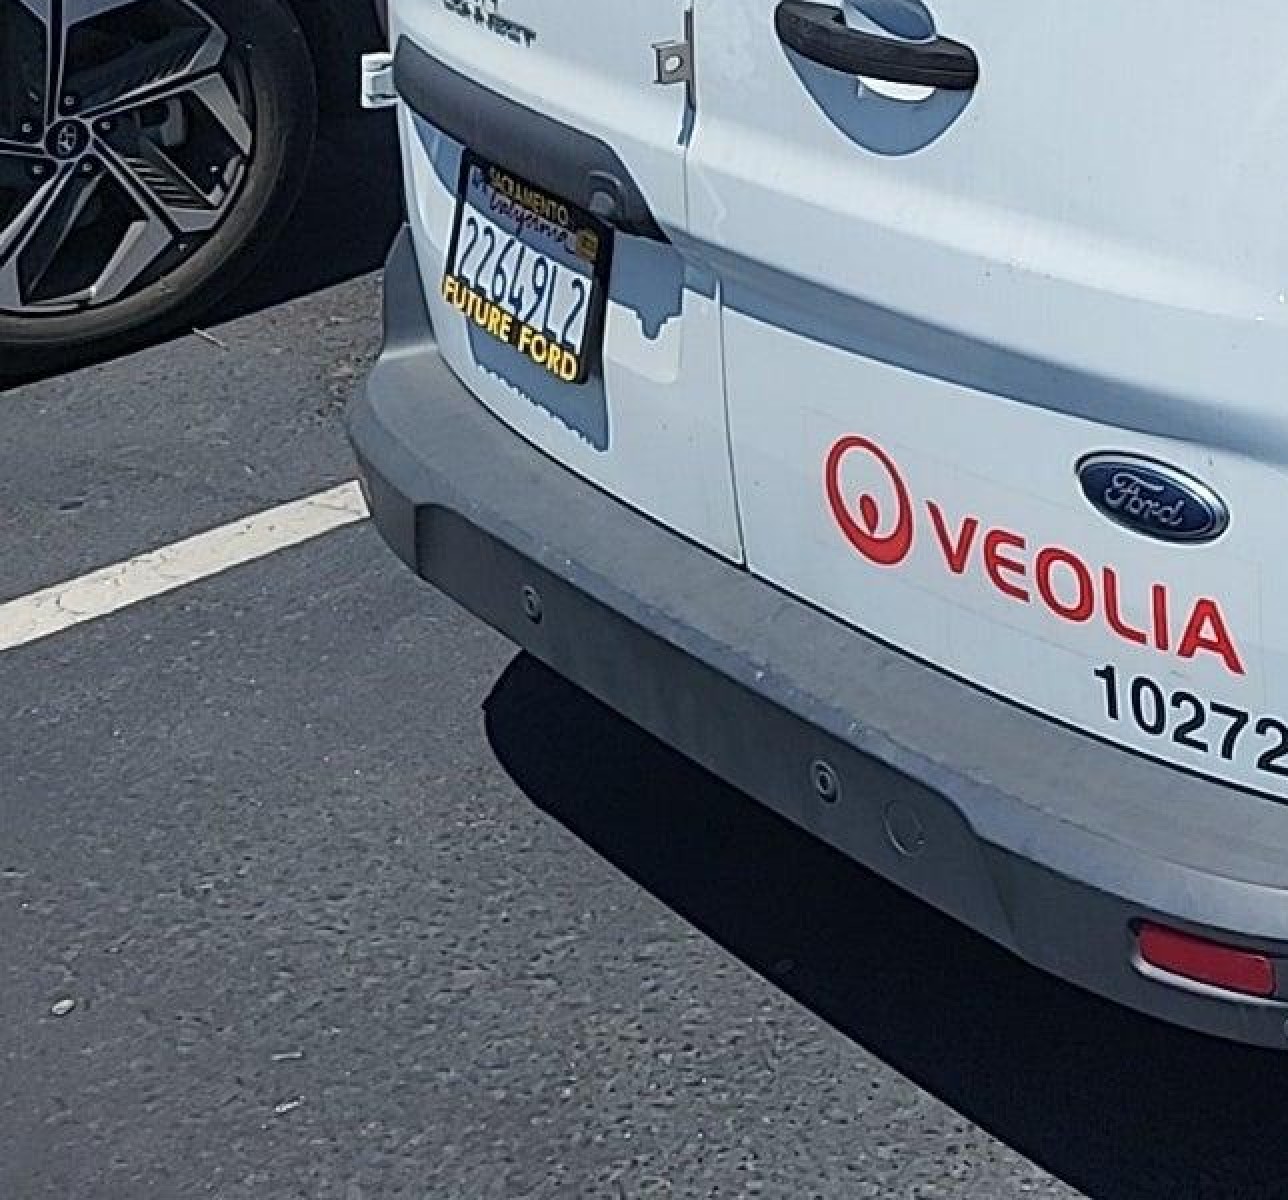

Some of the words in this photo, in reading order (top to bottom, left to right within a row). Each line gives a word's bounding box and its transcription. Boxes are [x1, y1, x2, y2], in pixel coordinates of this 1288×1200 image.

[443, 275, 512, 343] FUTURE
[517, 323, 578, 381] FORD
[457, 216, 590, 352] 22649L2
[1105, 472, 1184, 526] Ford
[926, 501, 1245, 675] VEOLIA
